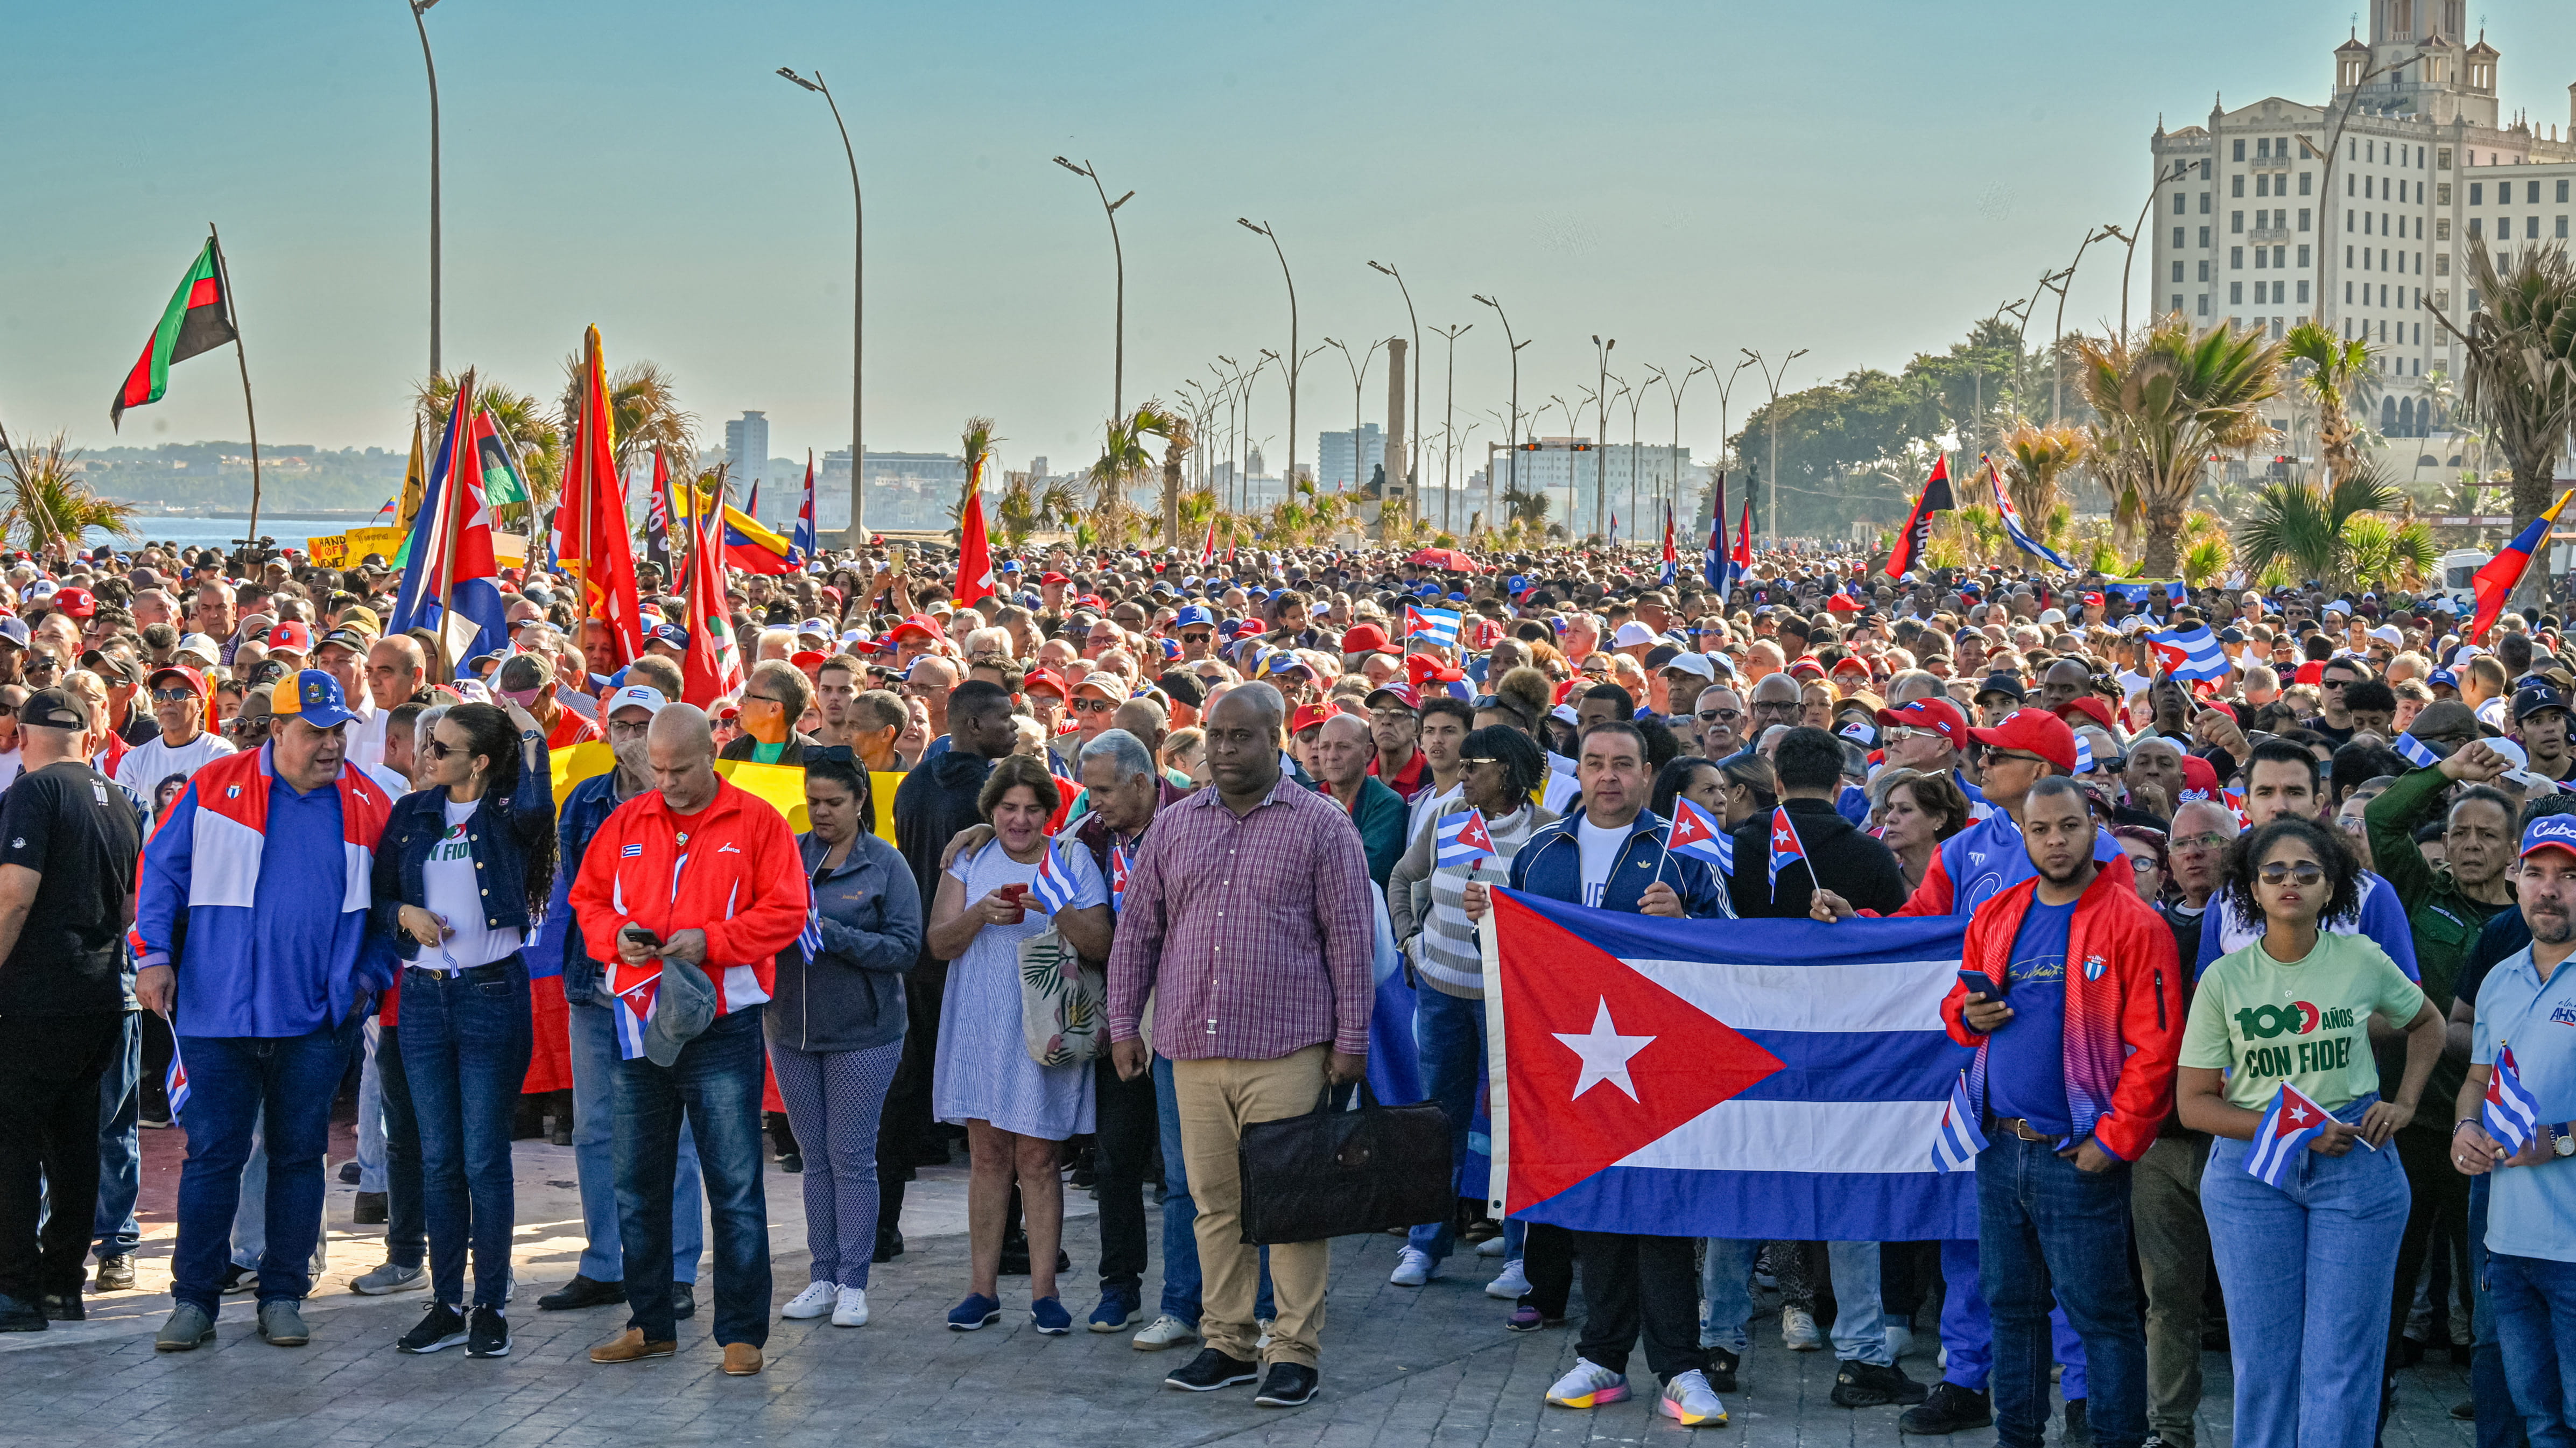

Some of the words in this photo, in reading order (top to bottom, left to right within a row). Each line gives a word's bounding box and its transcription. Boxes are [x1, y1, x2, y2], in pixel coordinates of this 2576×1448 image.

[354, 529, 388, 544] Tierra
[367, 543, 374, 552] y
[1425, 560, 1444, 568] Chile
[79, 594, 89, 606] C
[2234, 1001, 2320, 1041] 100
[2321, 1008, 2354, 1031] AÑOS
[2244, 1045, 2292, 1079] CON
[2298, 1036, 2352, 1074] FIDEL
